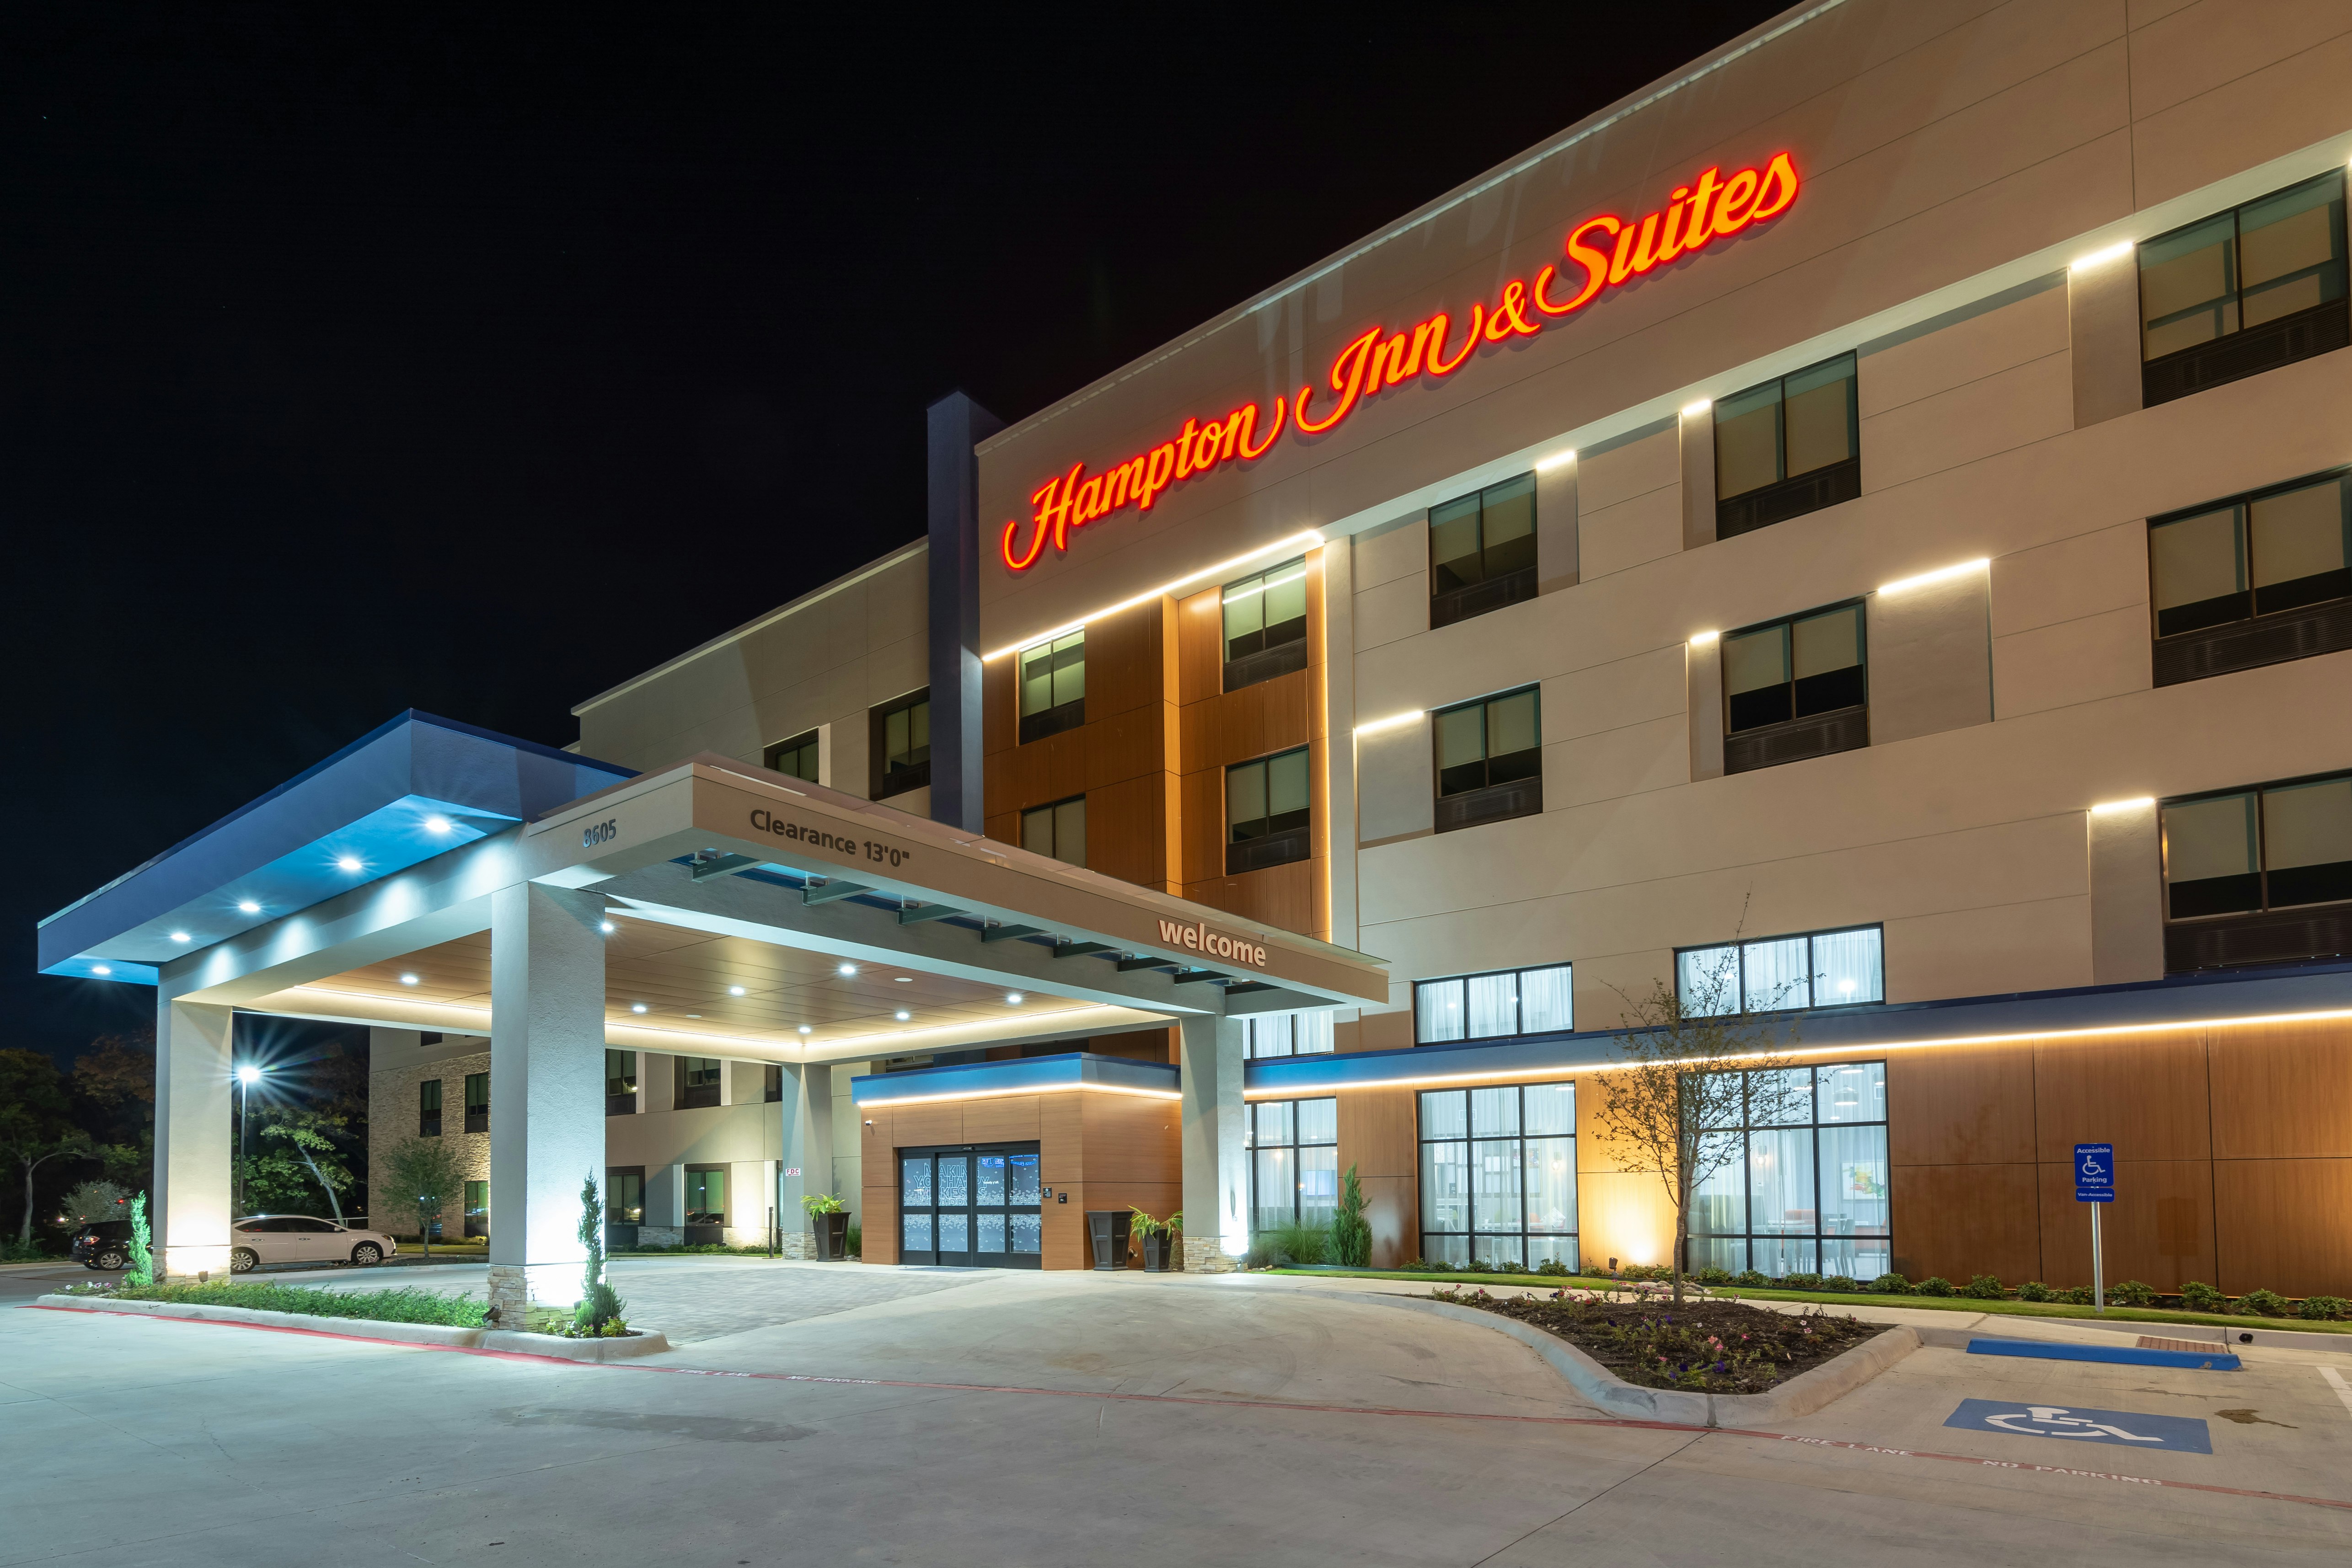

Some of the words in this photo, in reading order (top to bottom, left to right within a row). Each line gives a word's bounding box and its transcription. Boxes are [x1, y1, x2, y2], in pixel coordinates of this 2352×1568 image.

[1003, 396, 1288, 571] Hampton
[1294, 303, 1484, 434] Inn
[1484, 280, 1542, 342] &
[1533, 152, 1800, 316] Suites
[583, 818, 616, 848] 8605
[750, 809, 856, 855] Clearance
[863, 840, 910, 867] 13'0"
[1157, 920, 1266, 967] welcome
[1781, 1435, 1837, 1445] FIRE
[1848, 1444, 1916, 1456] LANE
[1983, 1460, 2019, 1468] NO
[2036, 1465, 2162, 1485] PARKING
